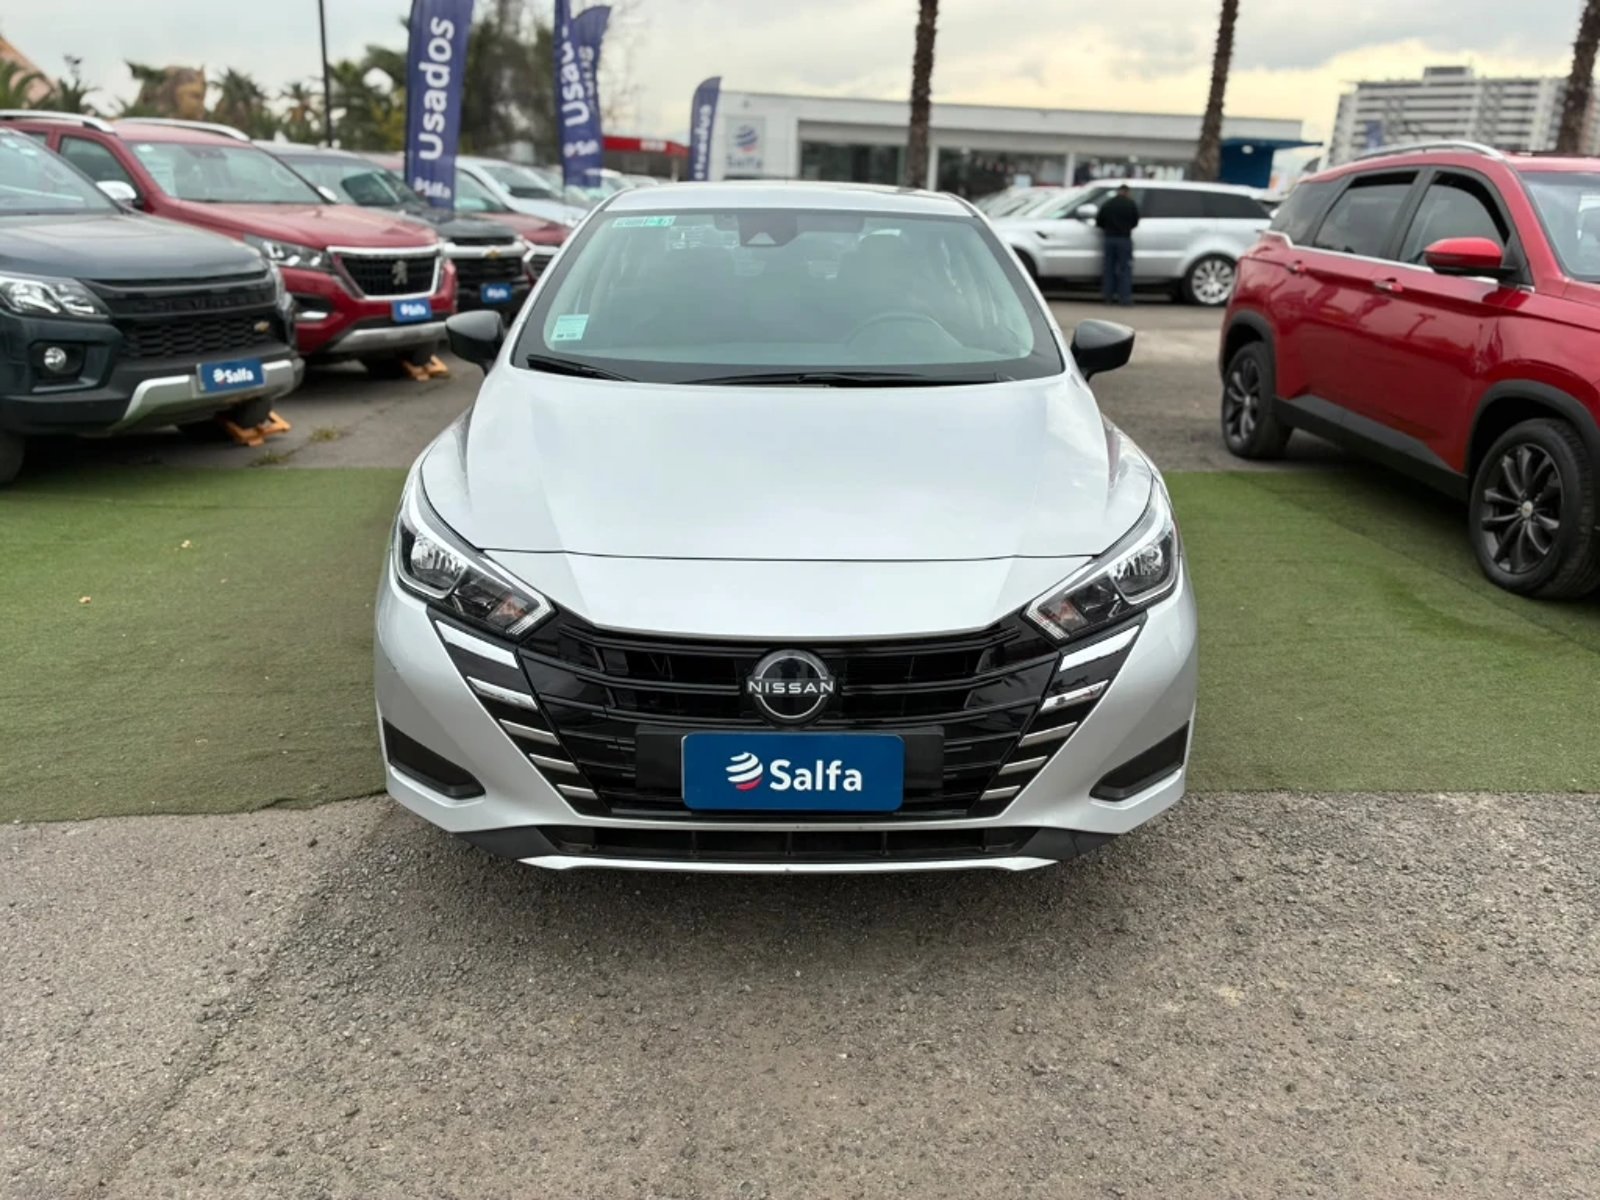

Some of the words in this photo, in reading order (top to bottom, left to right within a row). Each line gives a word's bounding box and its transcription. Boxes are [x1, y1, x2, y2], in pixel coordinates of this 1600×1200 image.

[418, 16, 455, 160] Usados
[225, 367, 254, 384] Salfa
[747, 680, 834, 694] NISSAN
[769, 759, 863, 792] Salfa
